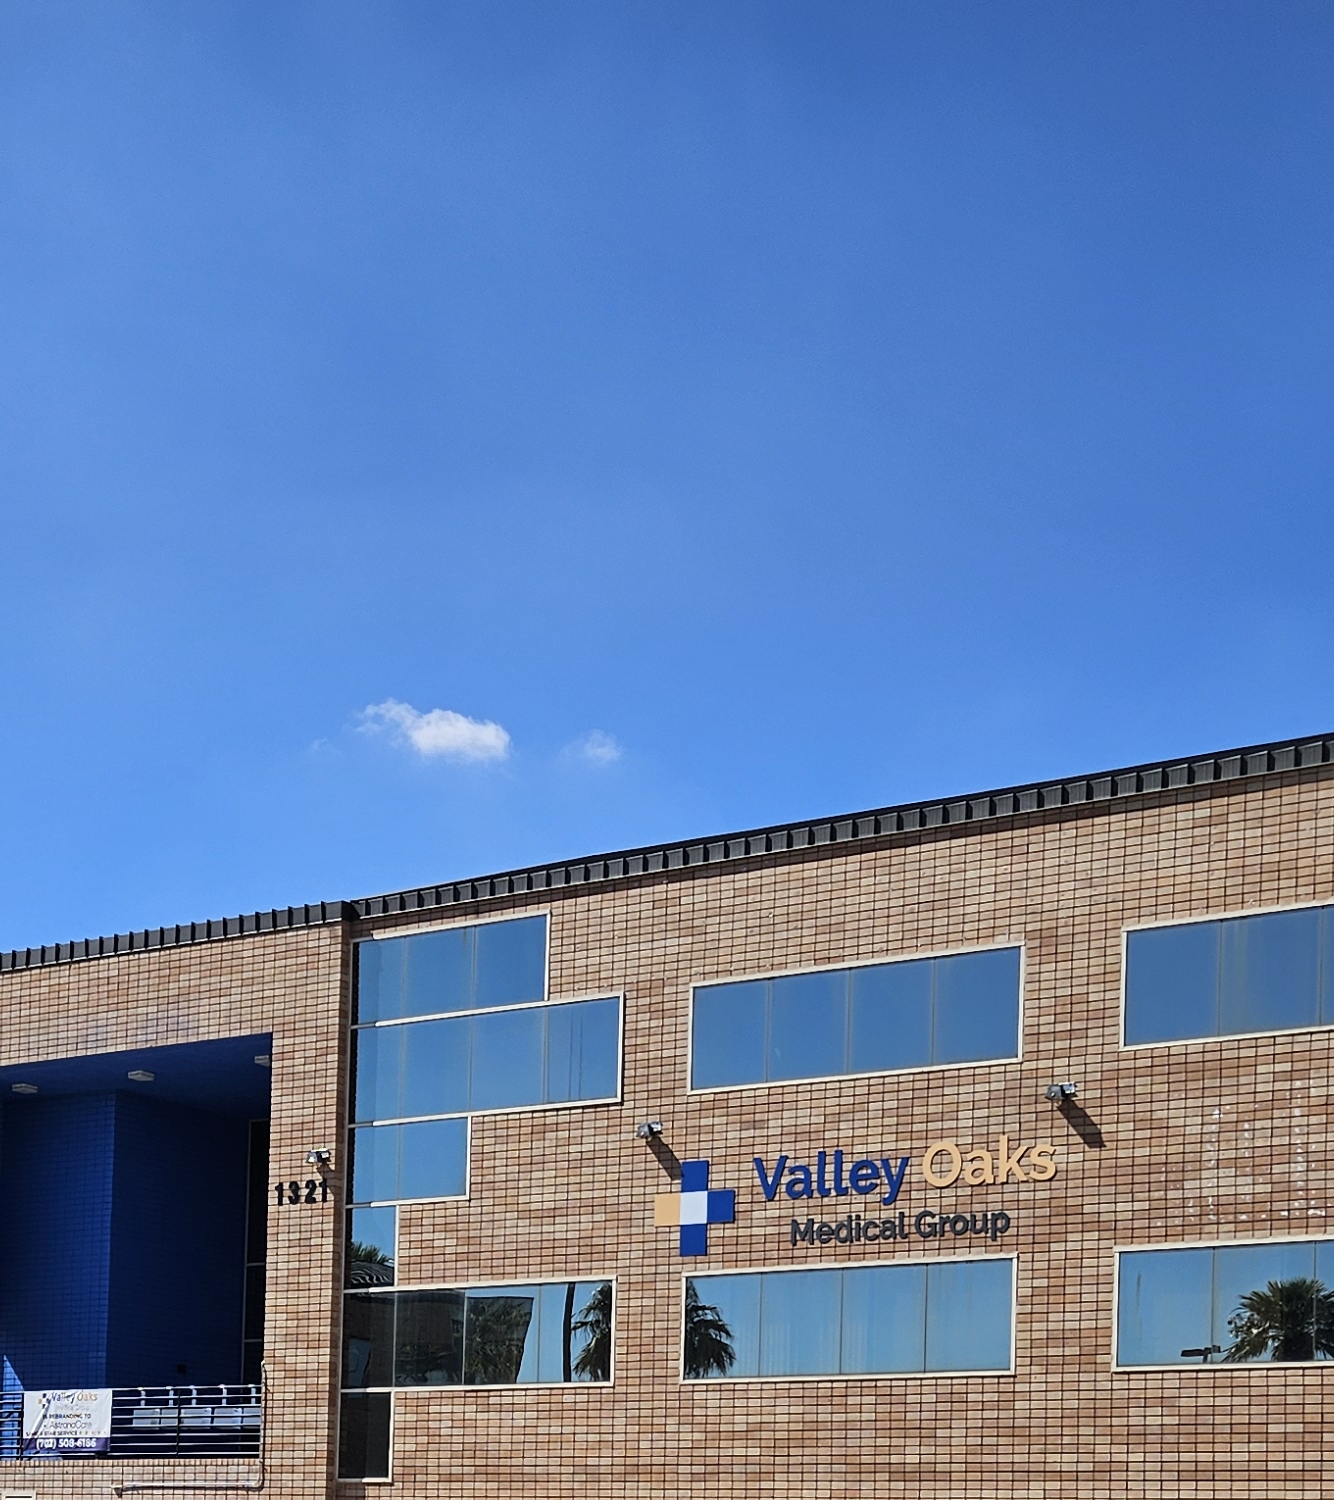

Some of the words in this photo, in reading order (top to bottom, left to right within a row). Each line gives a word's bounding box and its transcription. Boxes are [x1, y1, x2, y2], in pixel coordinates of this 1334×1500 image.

[753, 1150, 910, 1206] Valley
[922, 1135, 1058, 1189] Oaks
[275, 1178, 328, 1206] 1321
[790, 1211, 908, 1246] Medical
[914, 1210, 1011, 1241] Group
[77, 1391, 98, 1401] Oaks
